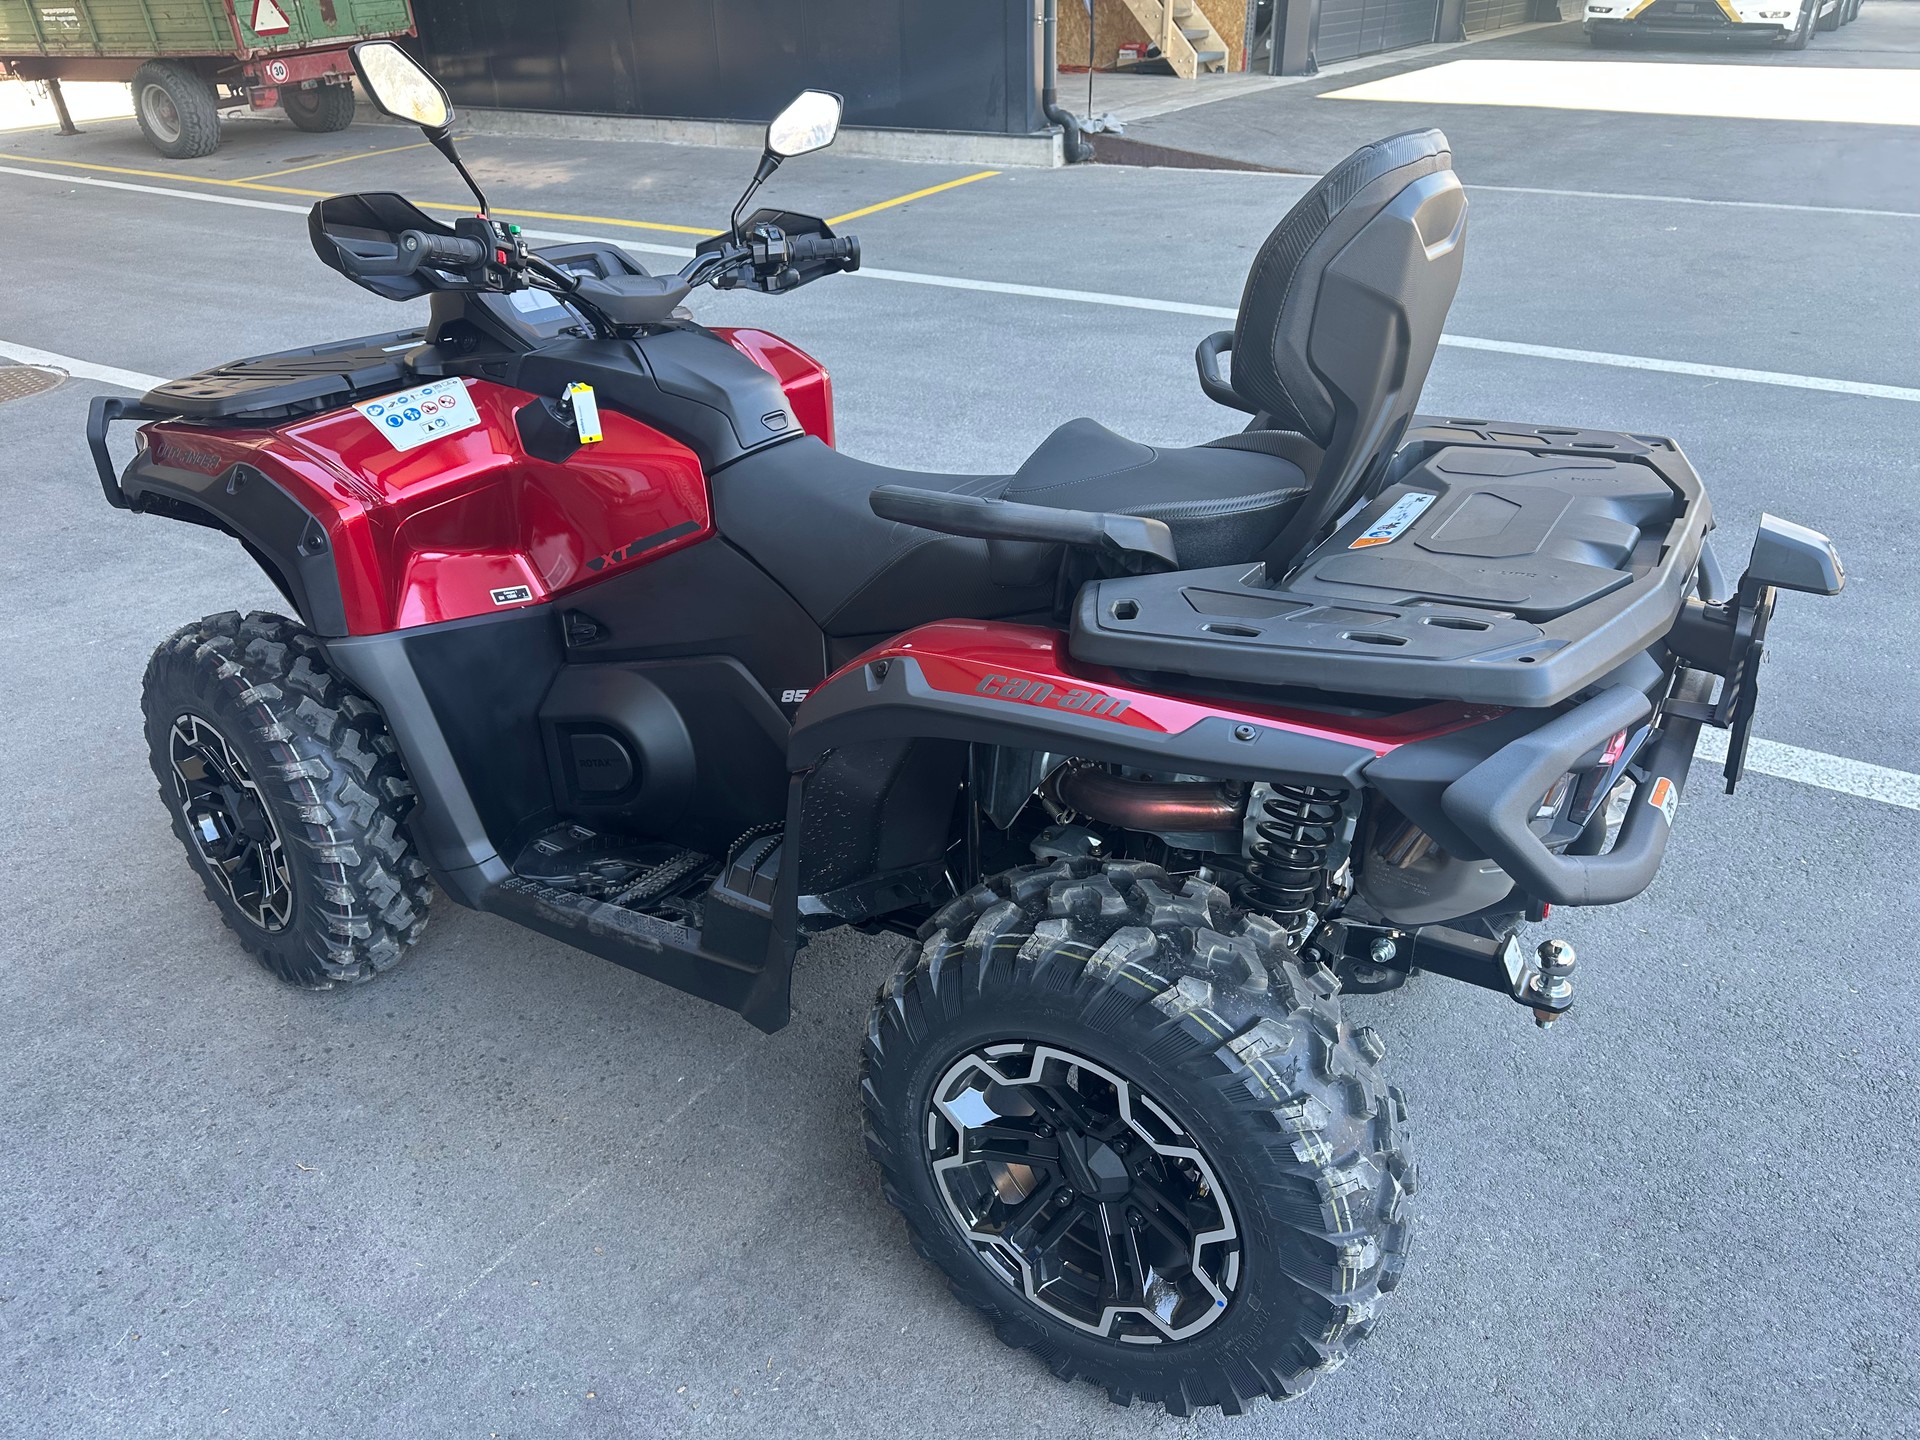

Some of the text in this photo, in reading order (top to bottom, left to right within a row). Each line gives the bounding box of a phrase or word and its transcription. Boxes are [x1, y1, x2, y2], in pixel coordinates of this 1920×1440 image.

[273, 65, 284, 76] 30
[600, 543, 632, 569] XT
[579, 758, 612, 768] ROTAX
